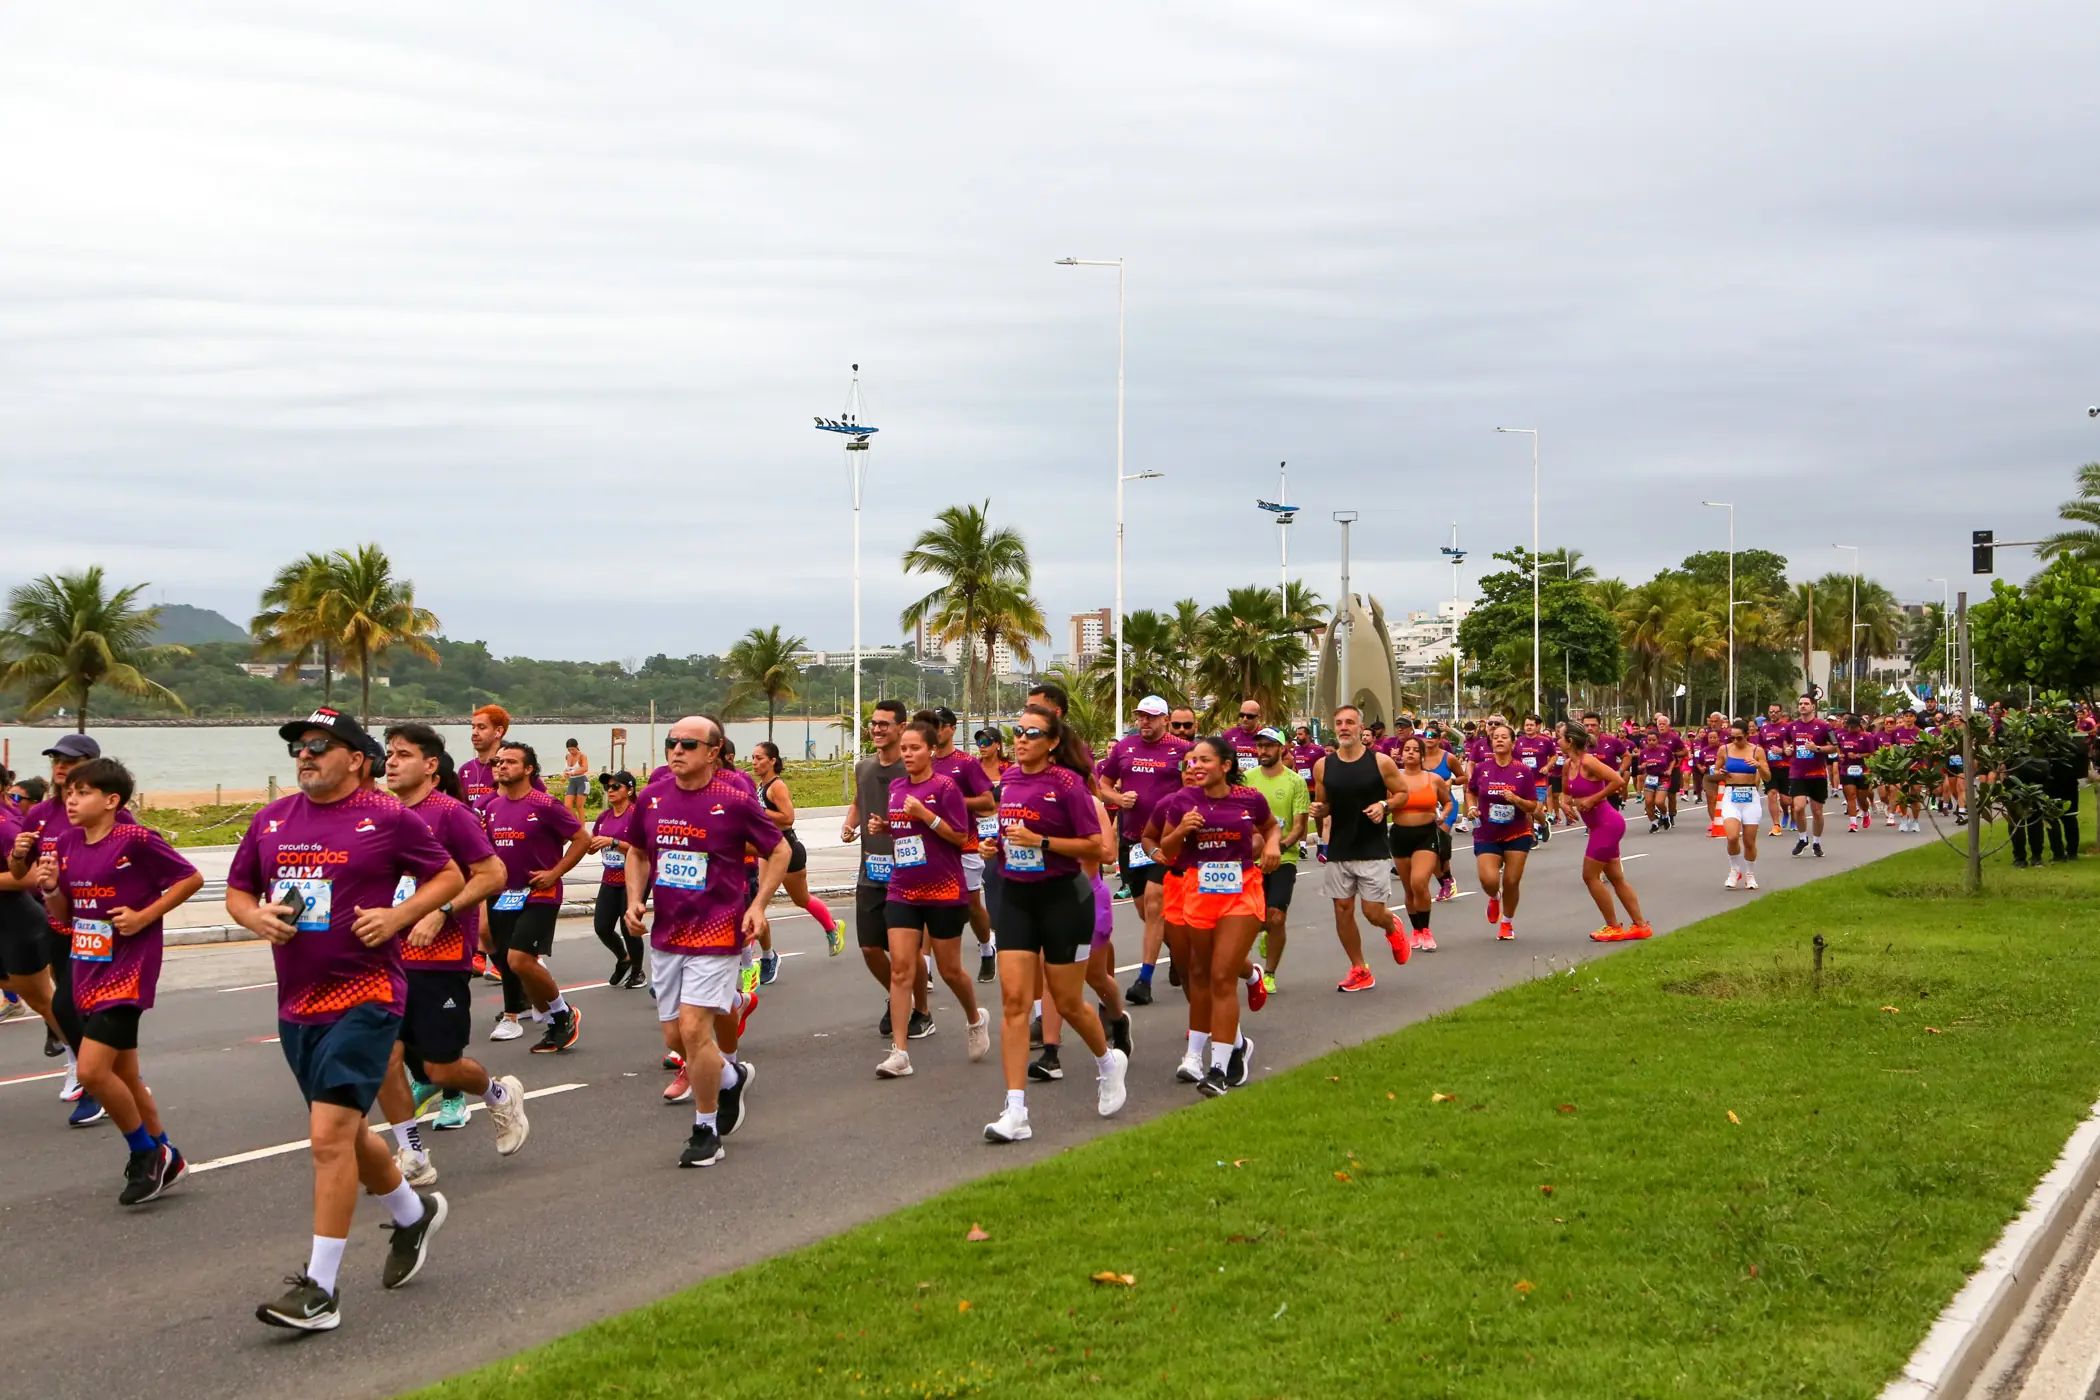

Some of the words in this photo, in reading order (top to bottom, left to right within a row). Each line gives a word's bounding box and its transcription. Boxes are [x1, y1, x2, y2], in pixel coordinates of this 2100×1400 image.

[1000, 807, 1040, 820] corridas
[890, 821, 912, 829] CAIXA
[493, 829, 525, 840] corridas
[656, 824, 707, 839] corridas
[1196, 830, 1241, 840] corridas
[495, 839, 514, 847] CAIXA
[656, 835, 689, 846] CAIXA
[1198, 840, 1227, 850] CAIXA
[278, 843, 310, 851] circuito
[310, 842, 322, 851] de
[276, 847, 349, 864] corridas
[667, 852, 693, 862] CAIXA
[277, 865, 323, 879] CAIXA
[664, 863, 698, 878] 5870
[870, 863, 891, 874] 1356
[1204, 872, 1236, 881] 5090
[75, 934, 102, 949] 3016
[406, 1126, 422, 1152] RUN
